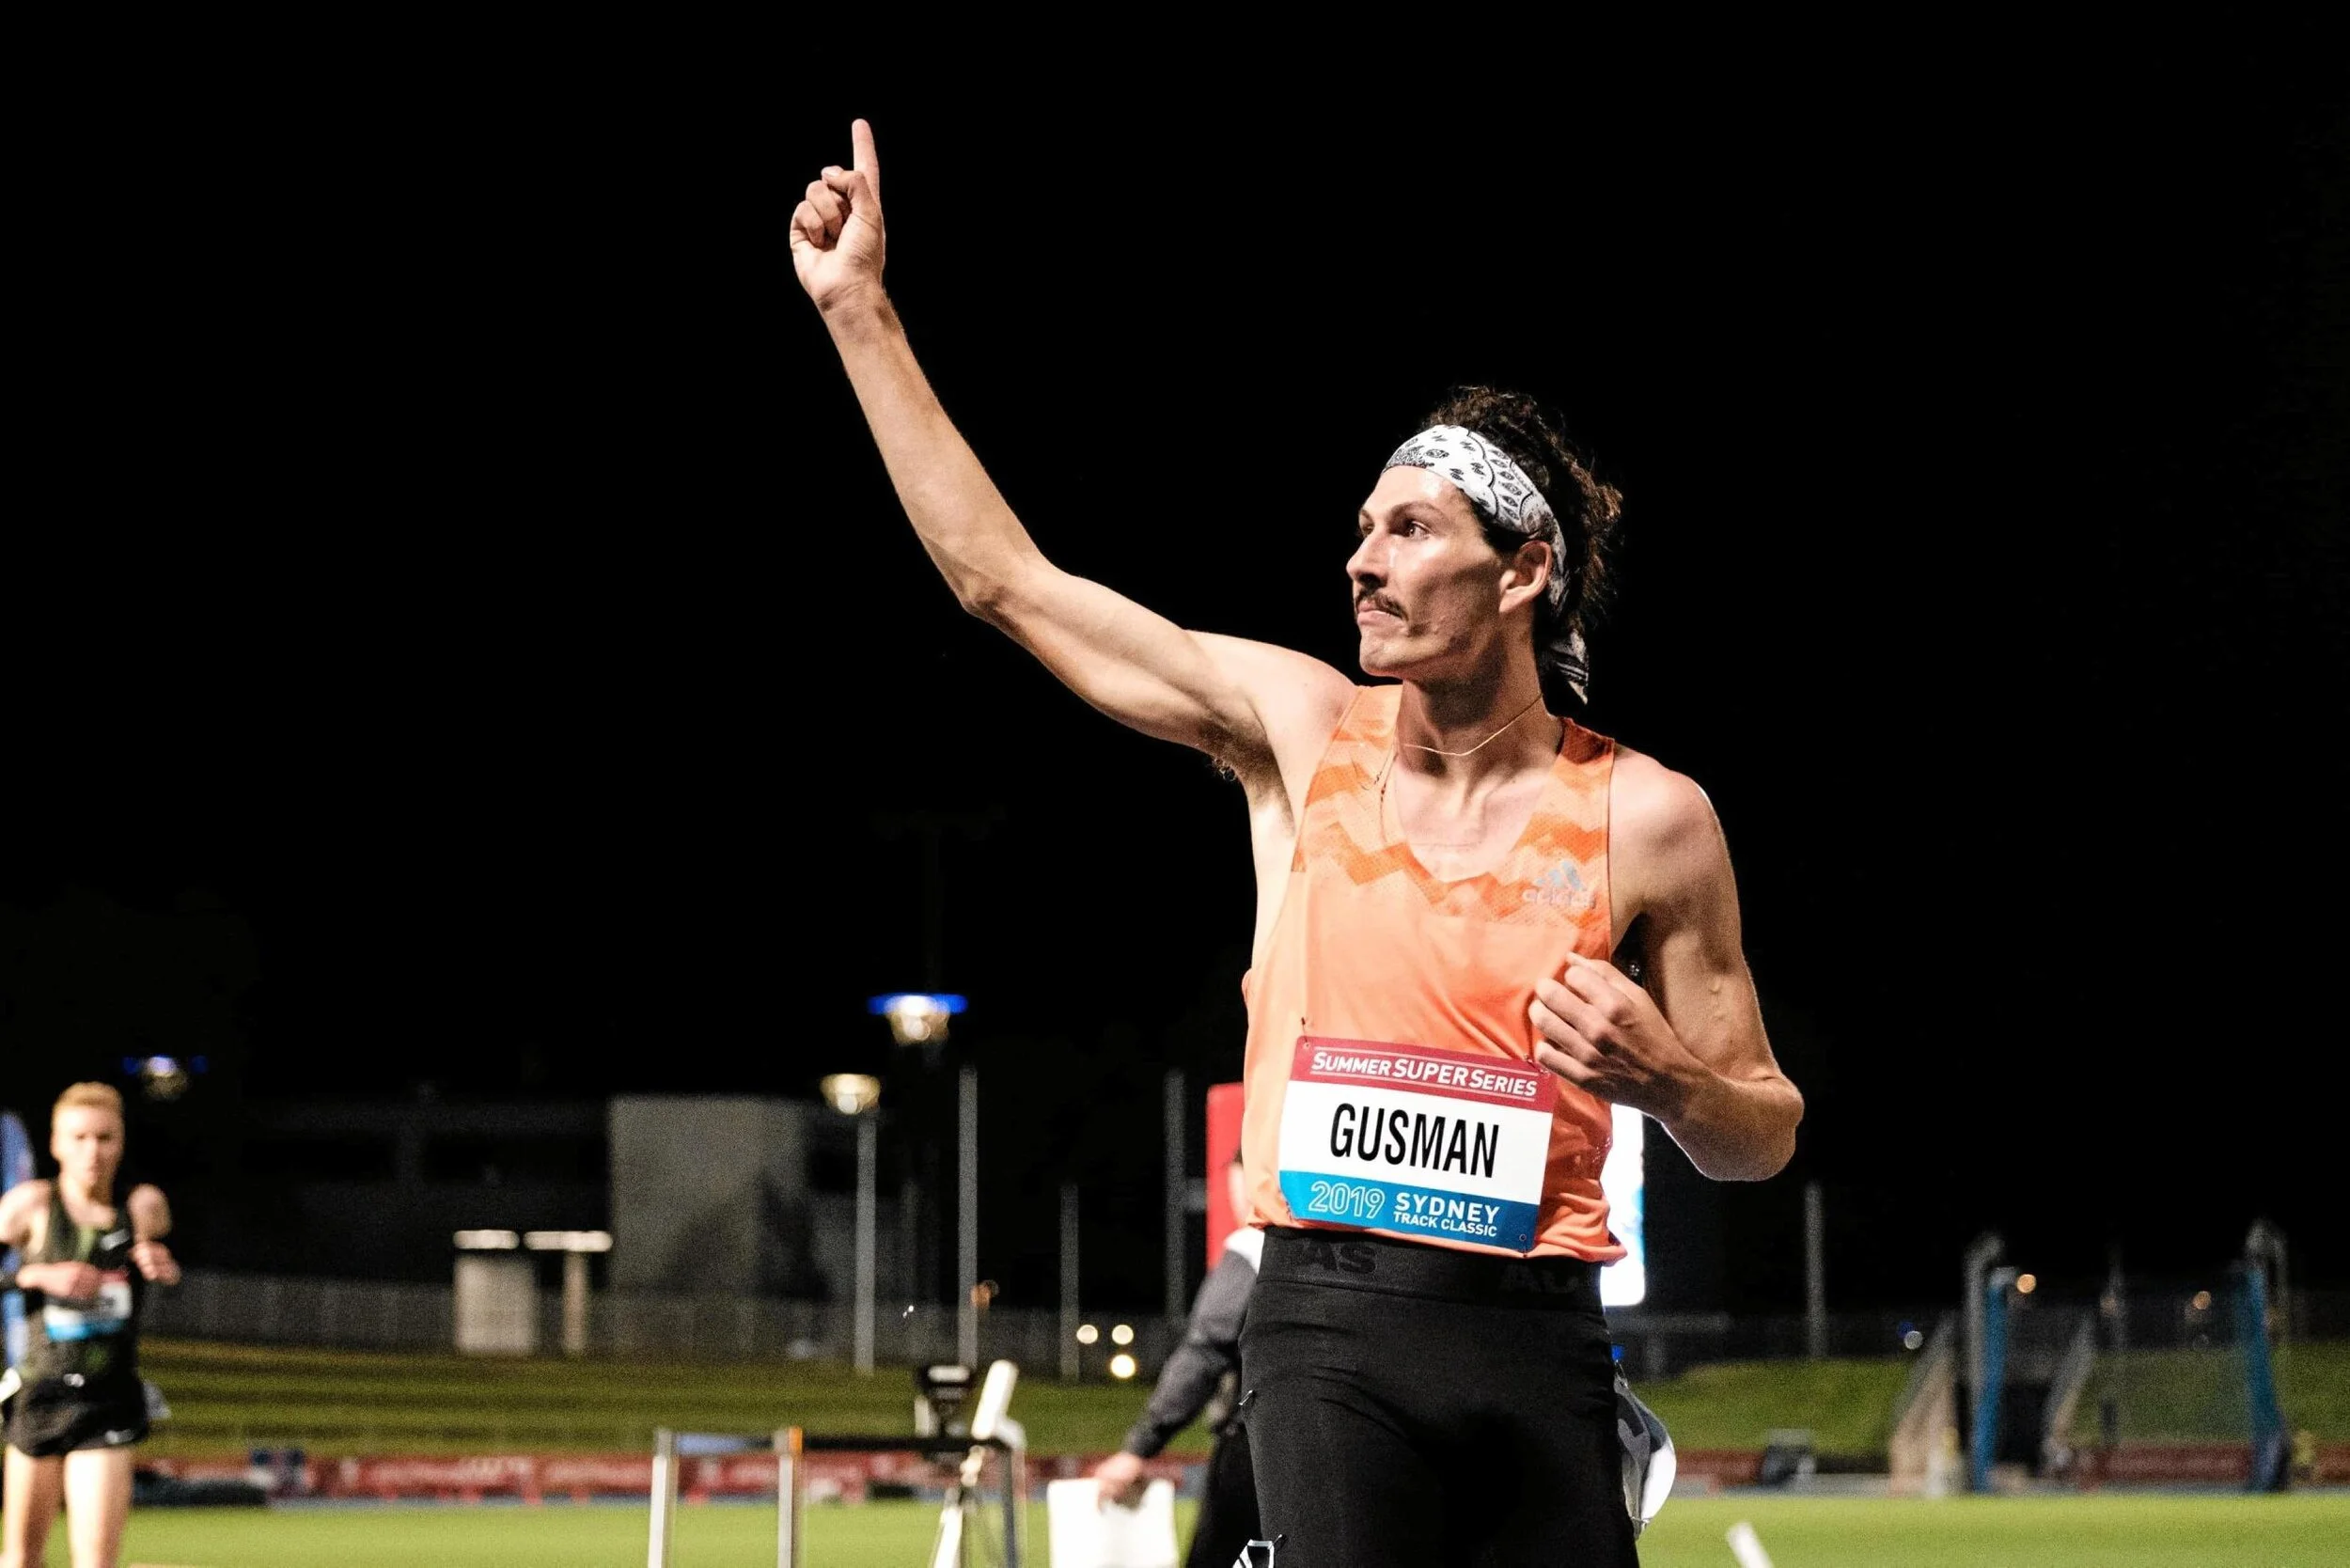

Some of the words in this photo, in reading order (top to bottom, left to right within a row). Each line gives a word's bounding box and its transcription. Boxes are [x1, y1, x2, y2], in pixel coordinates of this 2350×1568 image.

[1311, 1052, 1390, 1075] SUMMER
[1392, 1058, 1467, 1086] SUPER
[1468, 1070, 1538, 1097] SERIES
[1330, 1103, 1499, 1178] GUSMAN
[1309, 1181, 1385, 1219] 2019
[1394, 1192, 1500, 1224] SYDNEY
[1393, 1211, 1437, 1229] TRACK
[1440, 1217, 1497, 1237] CLASSIC
